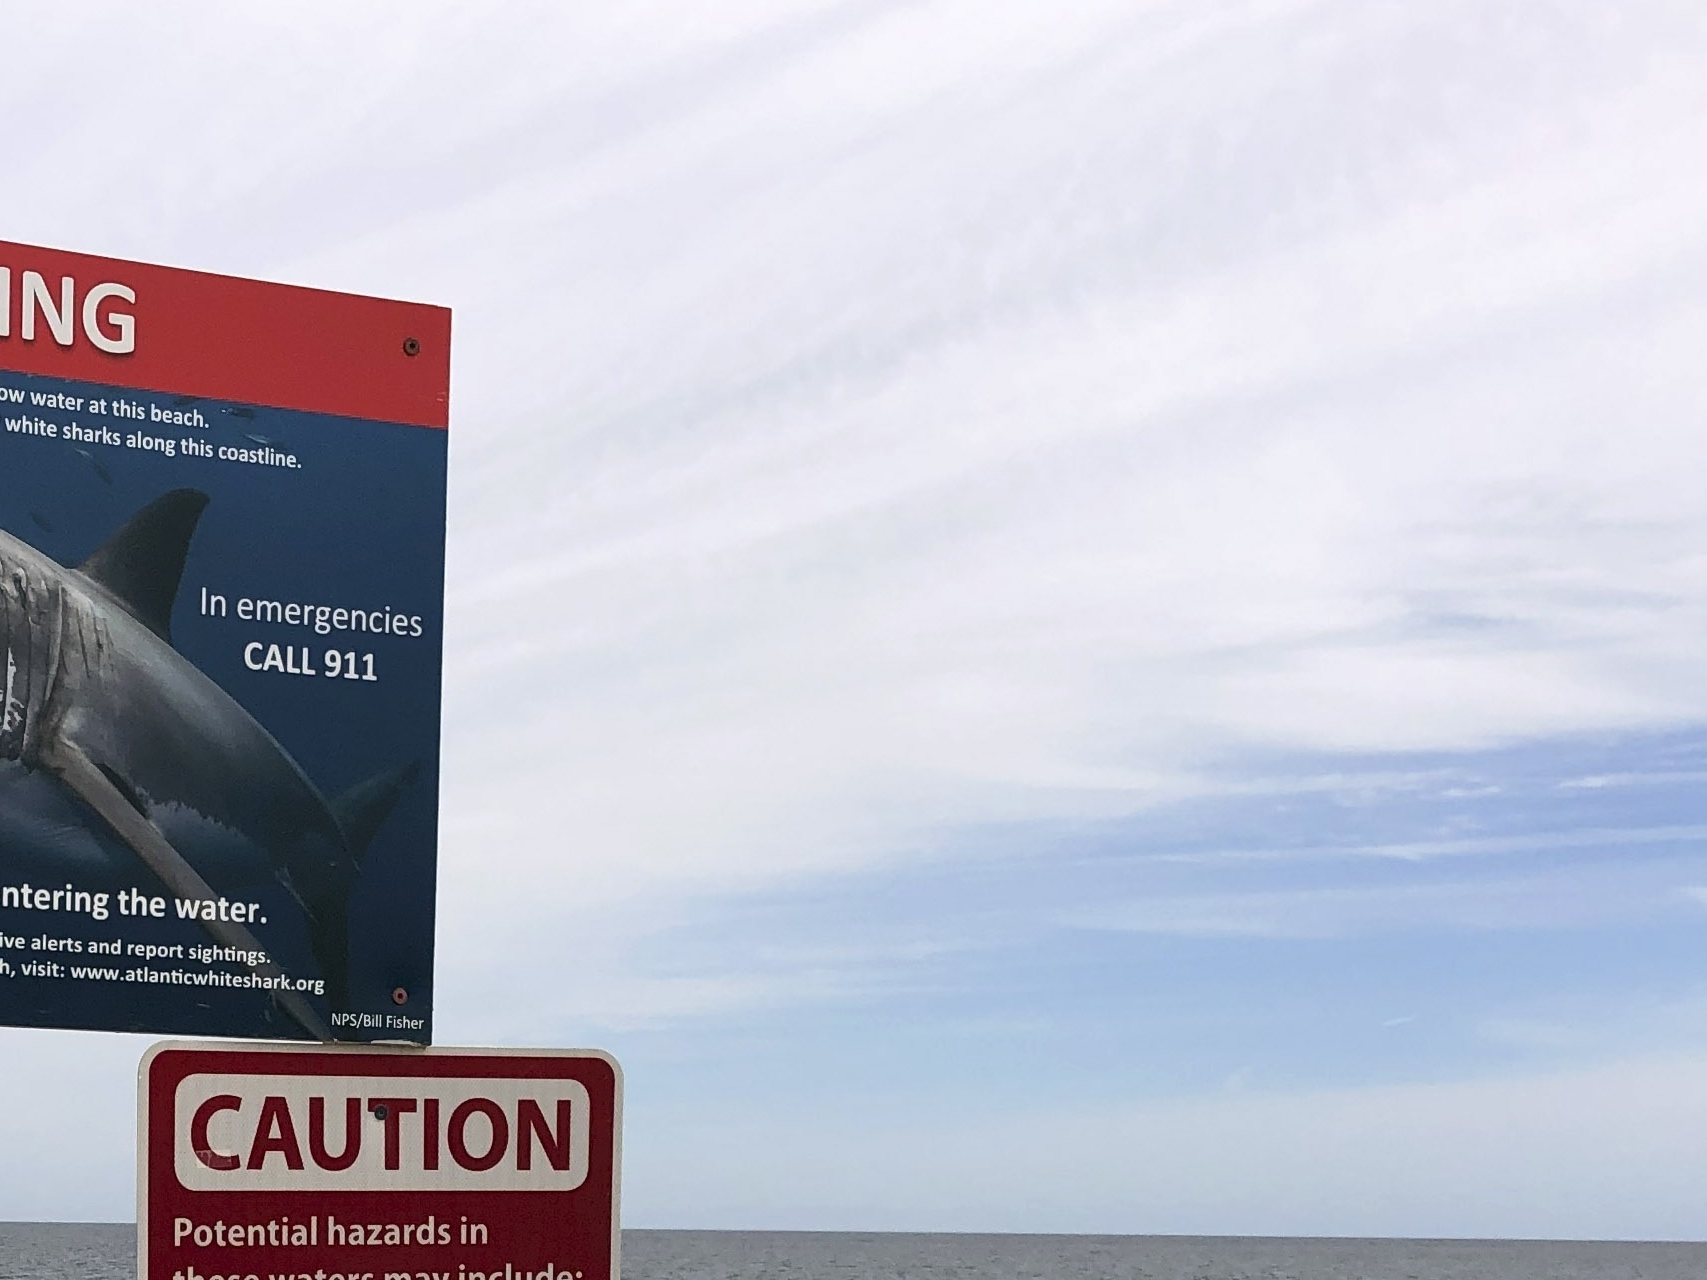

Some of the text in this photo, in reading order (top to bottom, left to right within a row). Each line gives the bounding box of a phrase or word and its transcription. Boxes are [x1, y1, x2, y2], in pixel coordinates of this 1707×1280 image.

[29, 391, 84, 411] water
[88, 398, 107, 414] at
[111, 398, 145, 420] this
[150, 403, 209, 428] beach.
[4, 415, 57, 437] white
[62, 421, 120, 445] sharks
[126, 430, 176, 457] along
[180, 437, 213, 457] this
[218, 446, 301, 468] coastline.
[201, 587, 422, 636] In emergencies
[244, 641, 377, 681] CALL 911
[117, 887, 166, 917] the
[174, 897, 266, 924] water.
[31, 934, 82, 952] alerts
[87, 938, 121, 955] and
[127, 943, 183, 960] report
[188, 944, 270, 966] sightings.
[21, 960, 64, 978] visit:
[70, 966, 324, 995] www.atlanticwhiteshark.org
[331, 1012, 424, 1029] NPS/Bill Fisher
[190, 1094, 571, 1172] CAUTION
[174, 1215, 487, 1246] Potential hazards in
